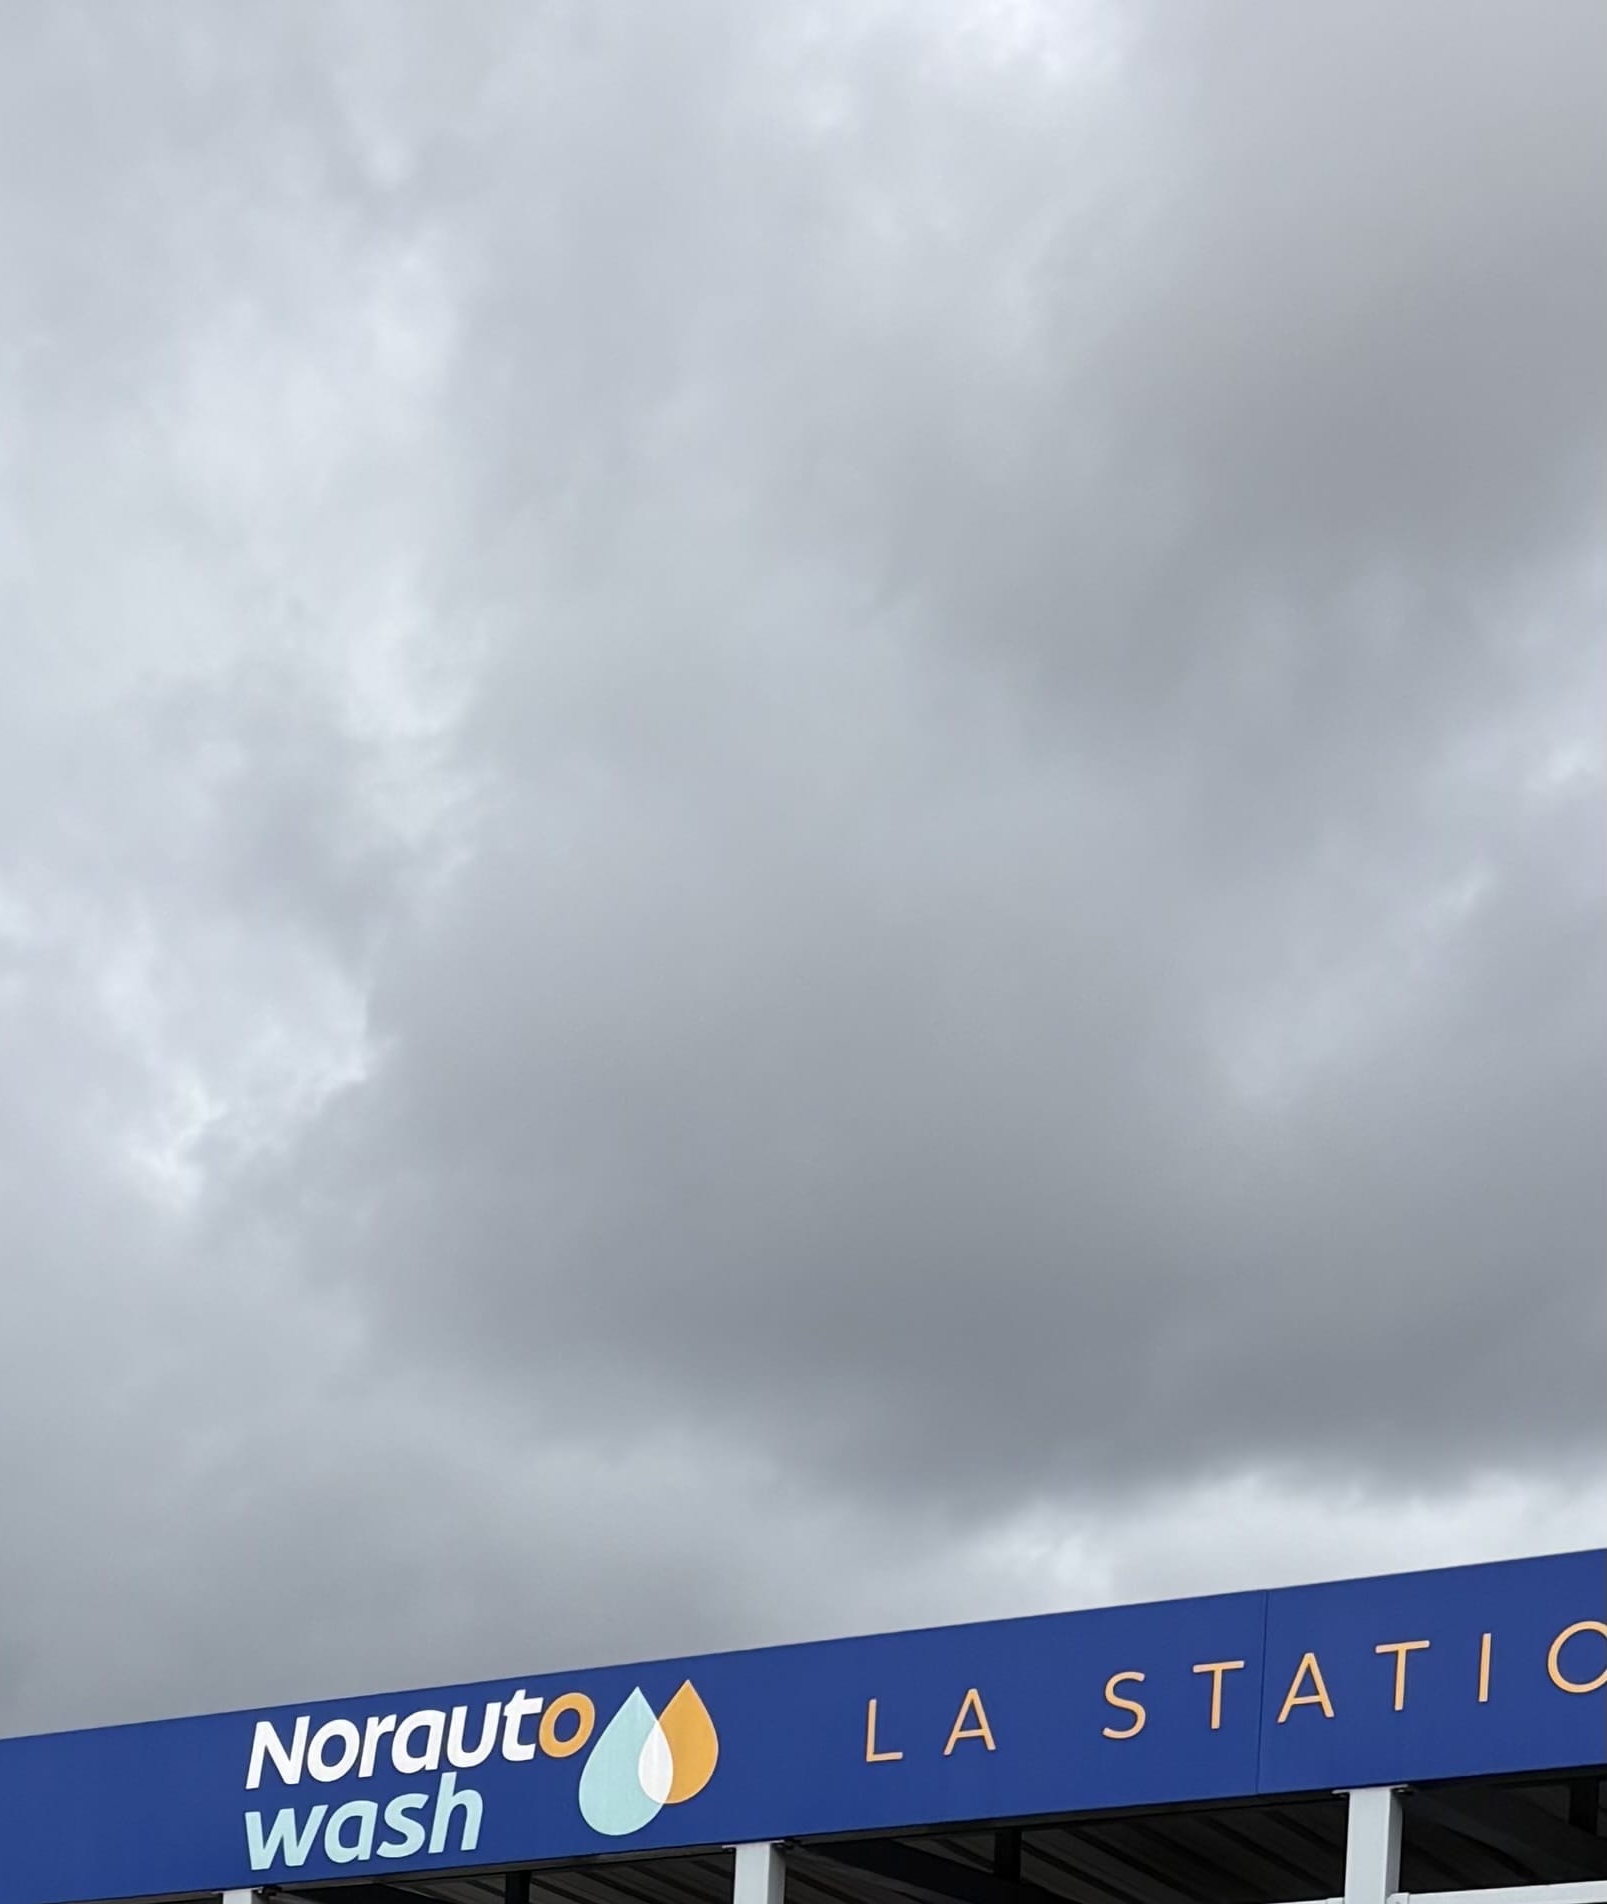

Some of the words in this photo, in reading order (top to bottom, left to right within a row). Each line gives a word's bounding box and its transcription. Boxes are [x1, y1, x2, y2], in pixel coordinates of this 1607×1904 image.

[244, 1688, 596, 1791] Norauto
[864, 1686, 997, 1763] LA
[1101, 1619, 1607, 1741] STATIO
[244, 1771, 484, 1871] wash
